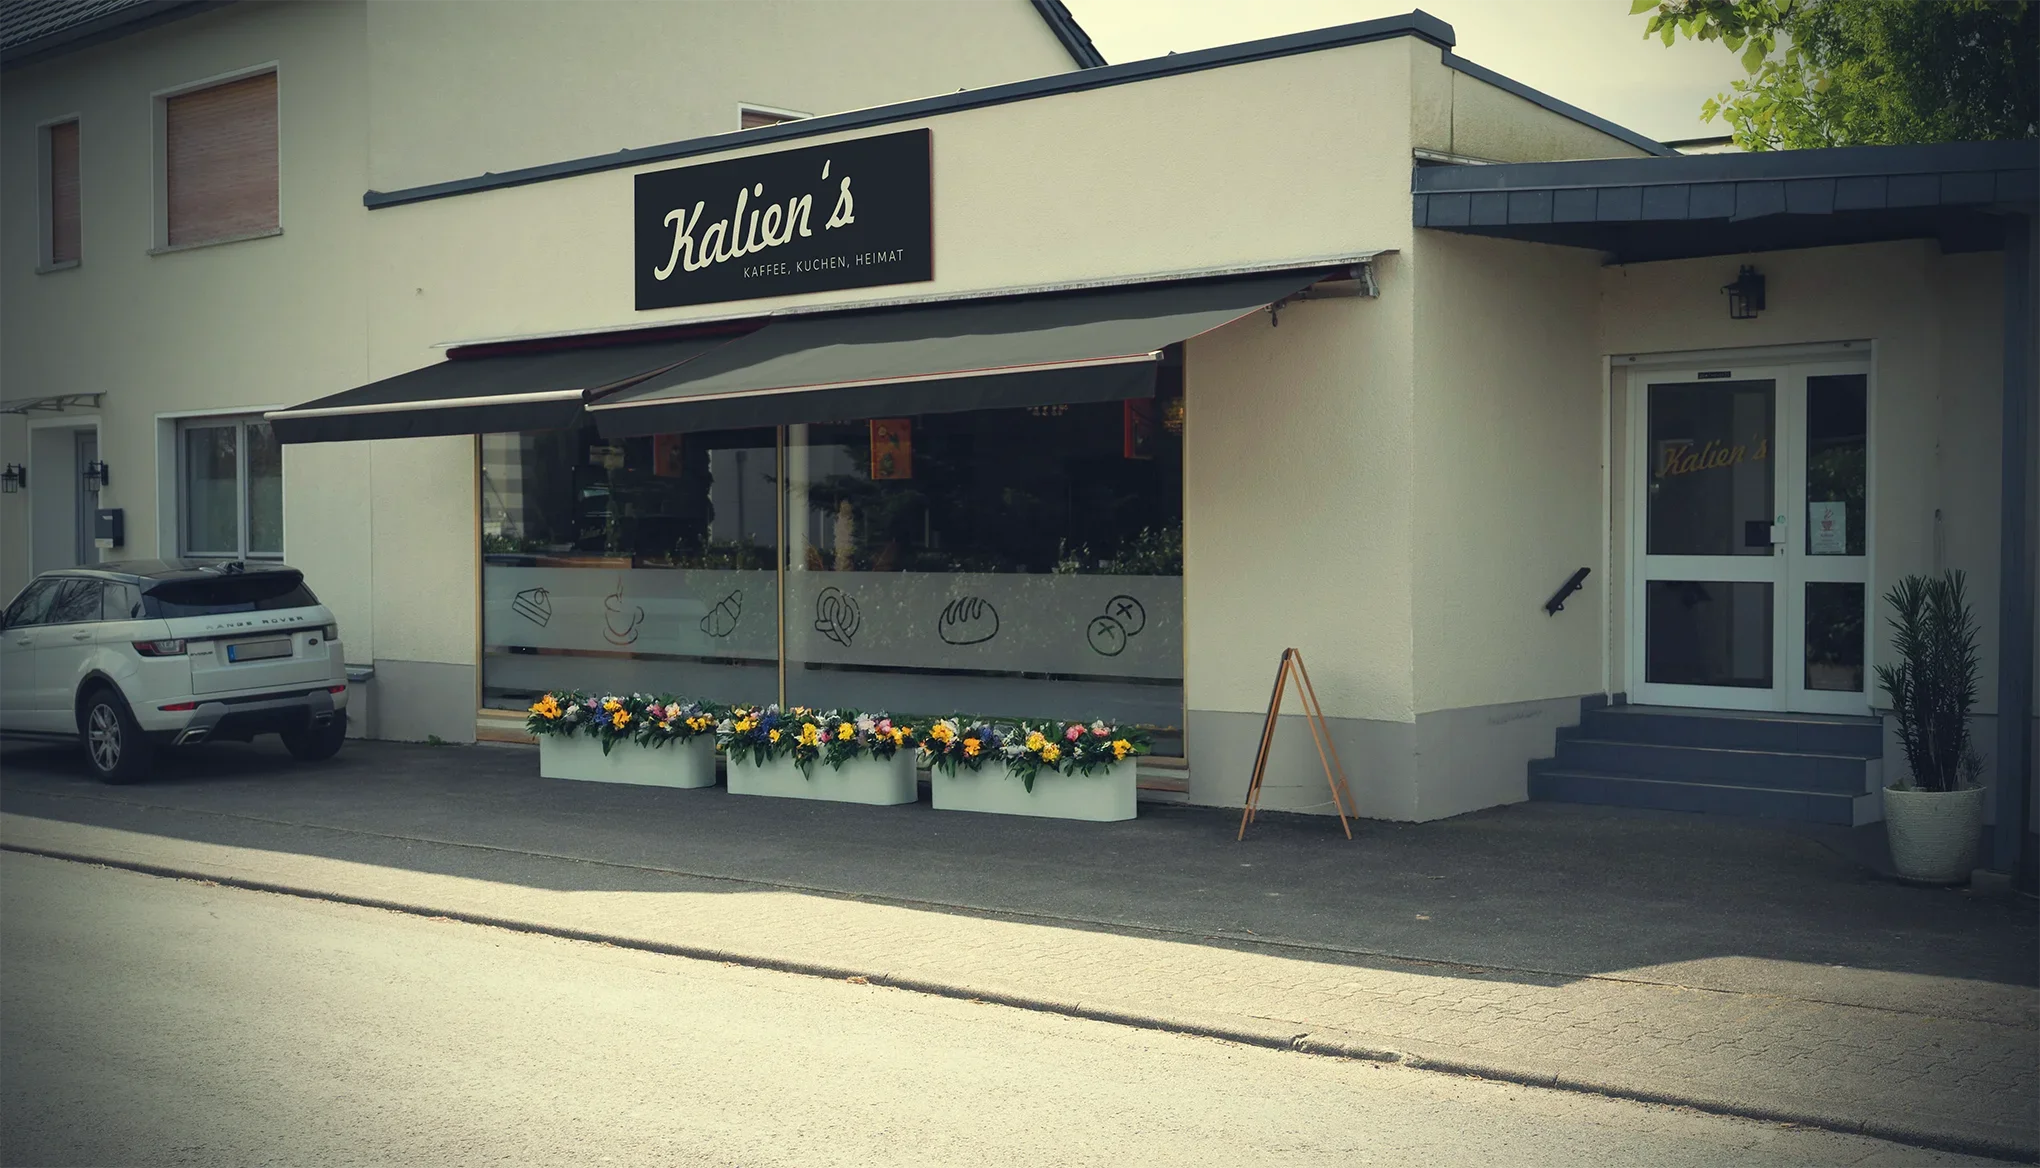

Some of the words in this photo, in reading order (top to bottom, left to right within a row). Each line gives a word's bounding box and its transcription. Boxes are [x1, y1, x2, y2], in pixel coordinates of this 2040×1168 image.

[654, 159, 854, 281] Kalien's
[743, 262, 791, 278] KAFFEE,
[796, 256, 850, 273] KUCHEN,
[855, 249, 904, 266] HEIMAT
[1656, 432, 1768, 478] Kalien's
[261, 616, 304, 624] ROVER
